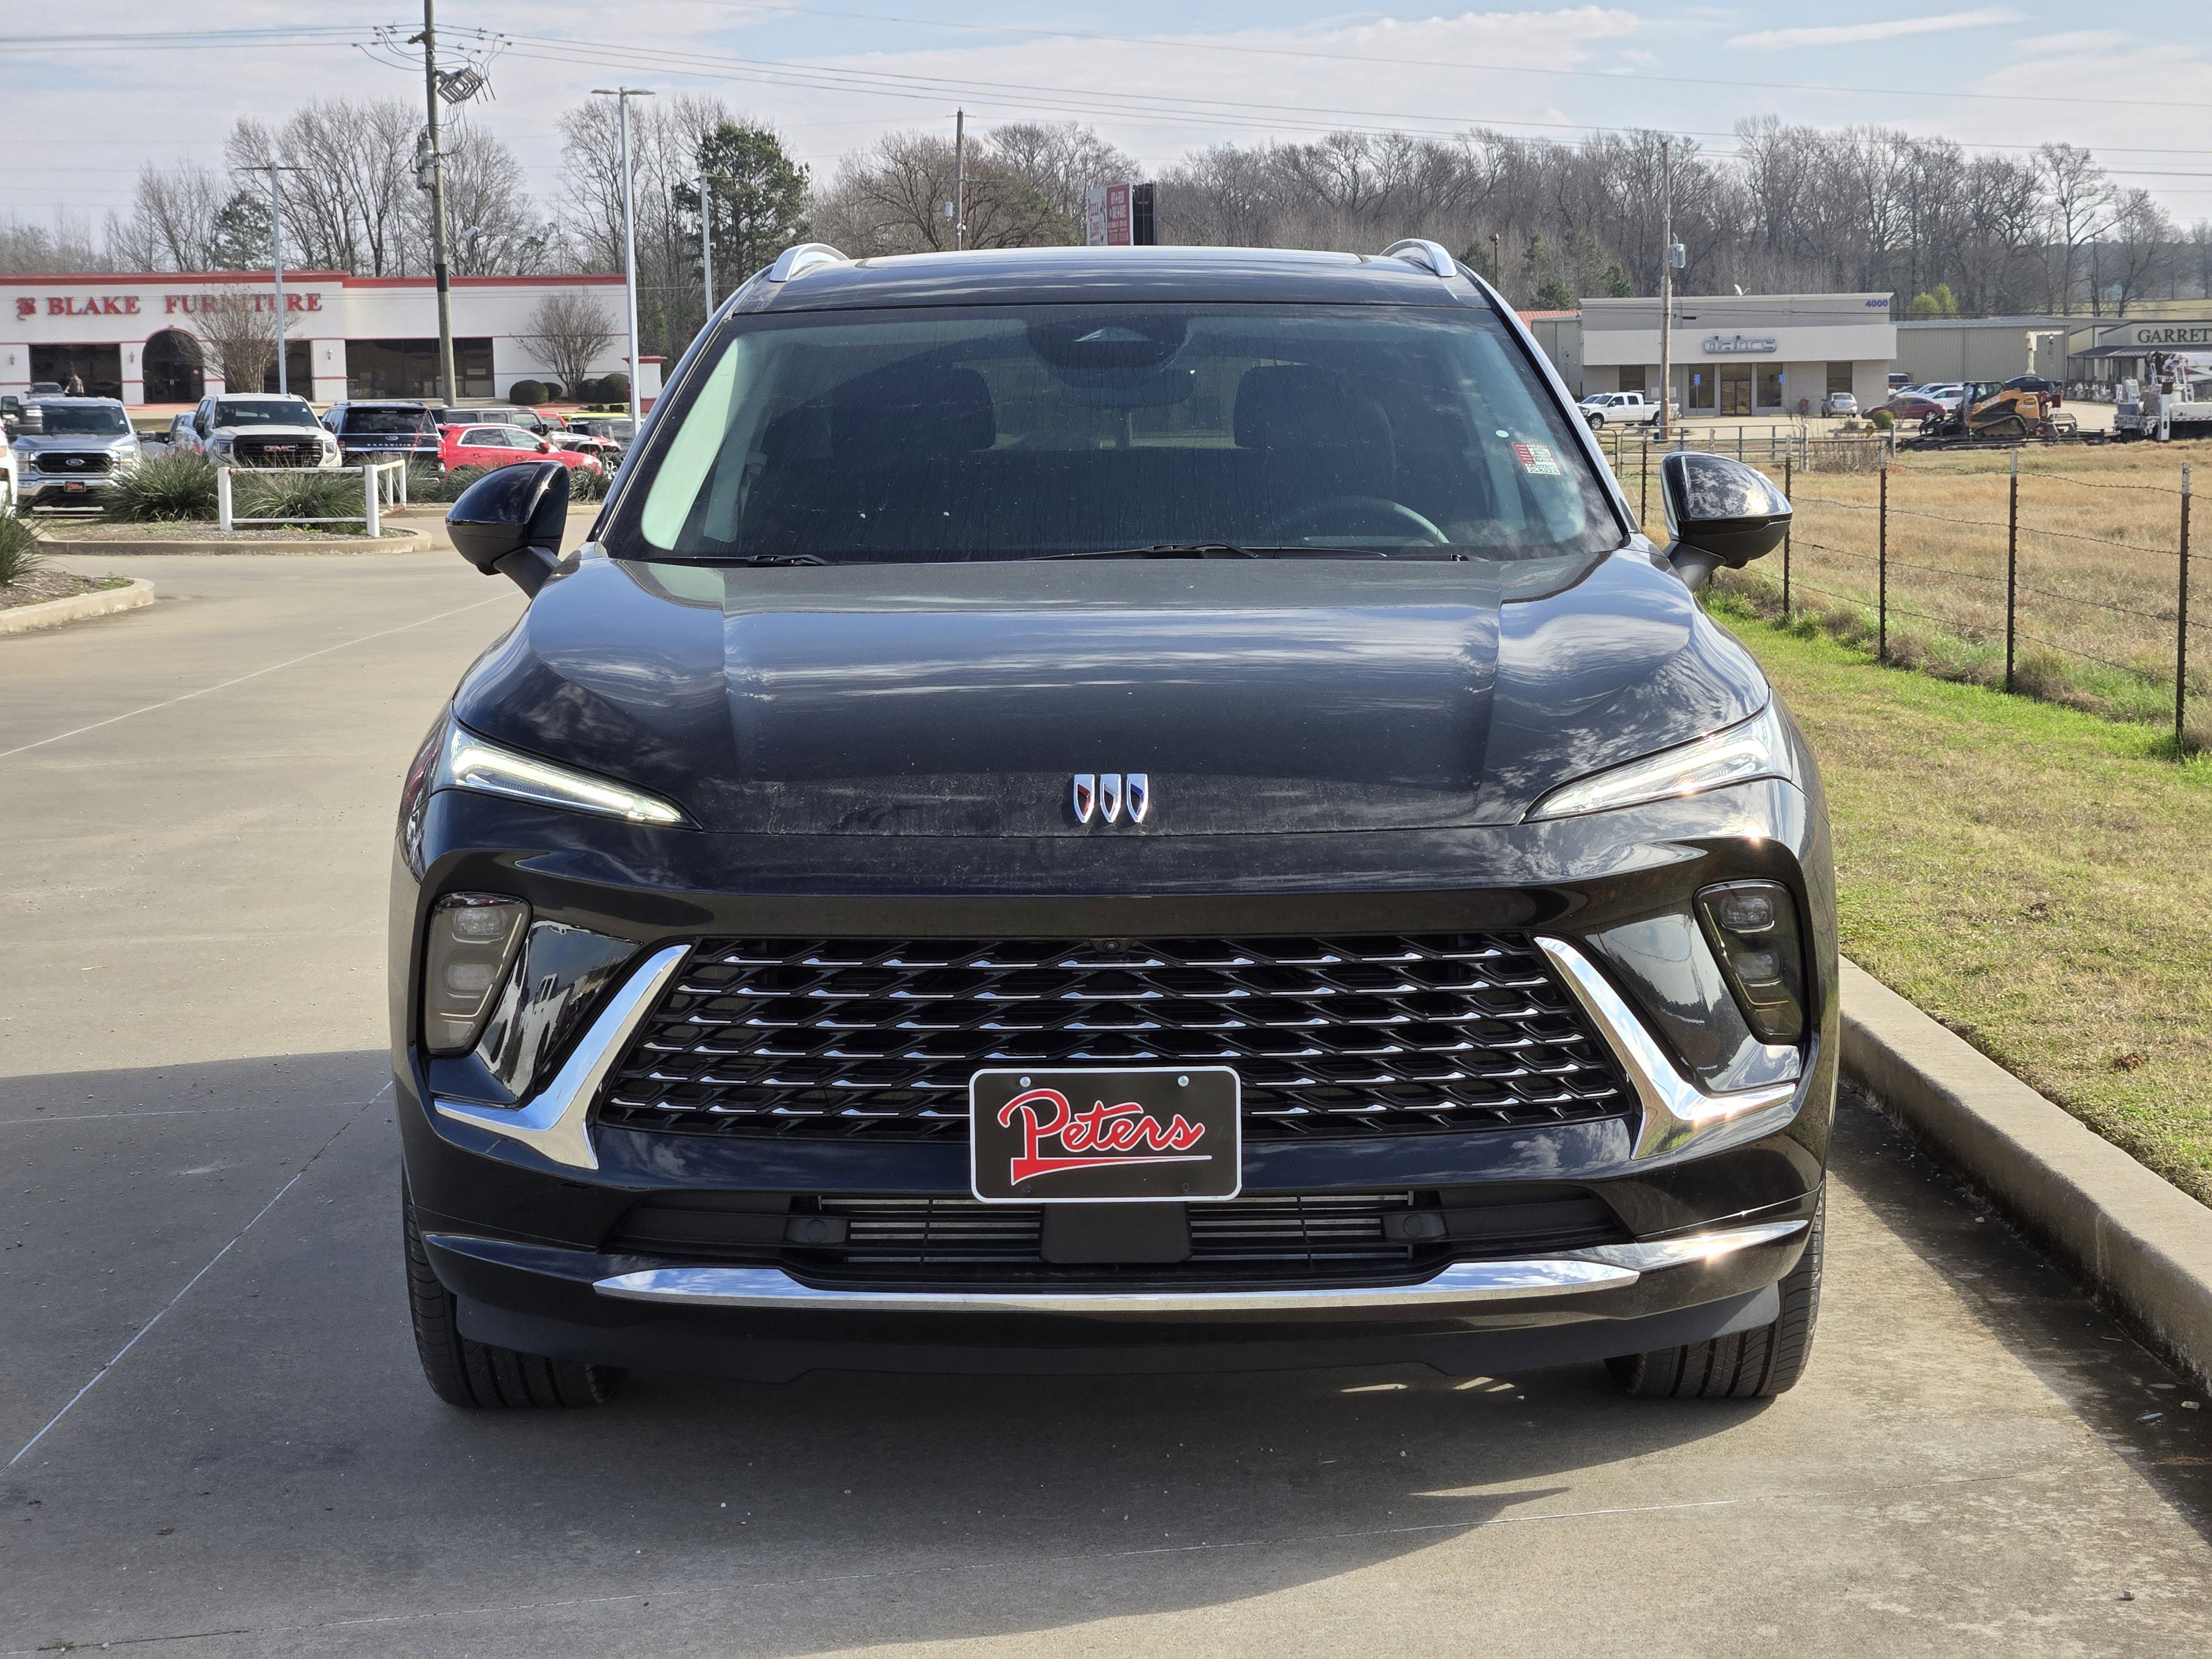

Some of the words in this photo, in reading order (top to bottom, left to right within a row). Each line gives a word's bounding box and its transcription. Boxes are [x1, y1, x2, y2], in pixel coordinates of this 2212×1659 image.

[47, 295, 141, 315] BLAKE
[1865, 299, 1888, 307] 4000
[997, 1088, 1206, 1160] Peters
